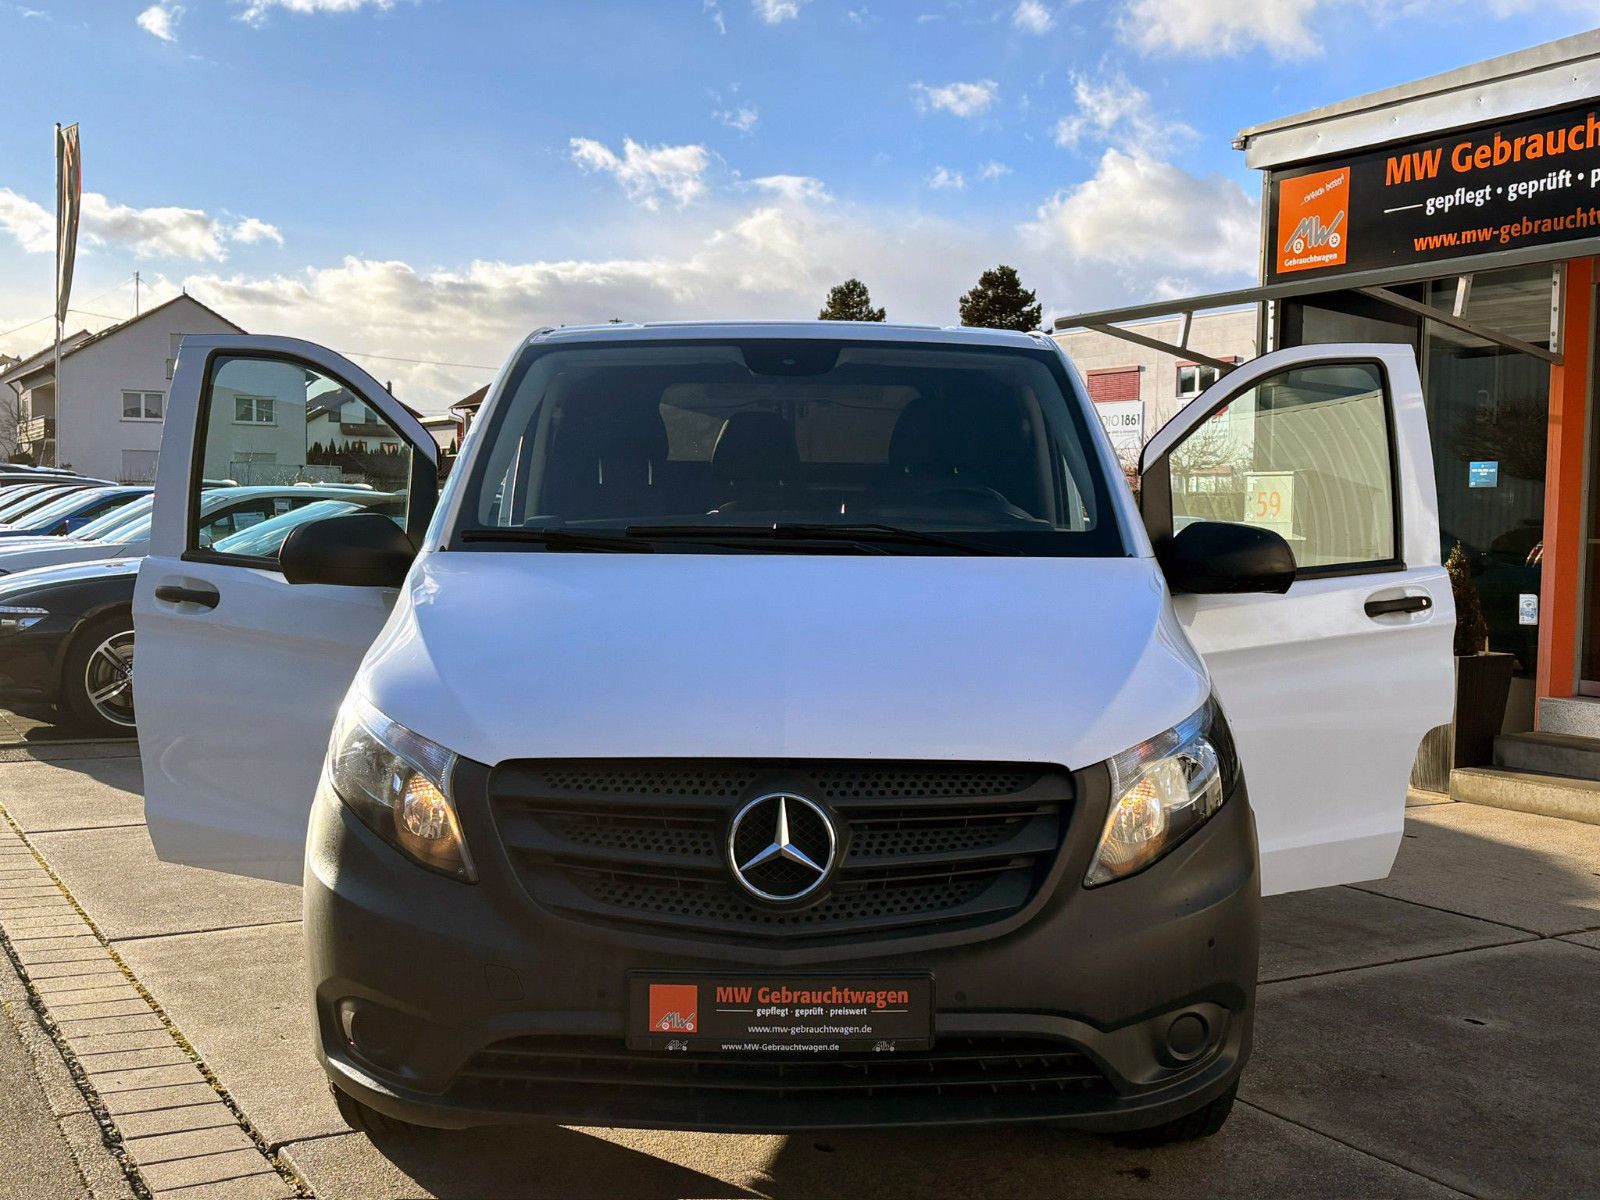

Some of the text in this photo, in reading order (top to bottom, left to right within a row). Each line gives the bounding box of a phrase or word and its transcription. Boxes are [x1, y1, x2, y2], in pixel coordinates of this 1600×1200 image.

[1385, 148, 1442, 186] MW
[1426, 185, 1491, 216] gepflegt
[1508, 169, 1572, 201] geprüft
[1413, 207, 1600, 252] www.mw-gebraucht
[1284, 252, 1338, 267] Gebrauchtwagen
[1121, 413, 1141, 426] 1861
[1256, 490, 1281, 517] 59
[715, 986, 909, 1008] MW Gebrauchtwagen
[756, 1006, 868, 1017] gepflegt geprüft preiswert
[748, 1024, 872, 1036] www.mw-gebrauchtwagen.de
[721, 1041, 840, 1053] www.MW-Gebrauchtwagen.de
